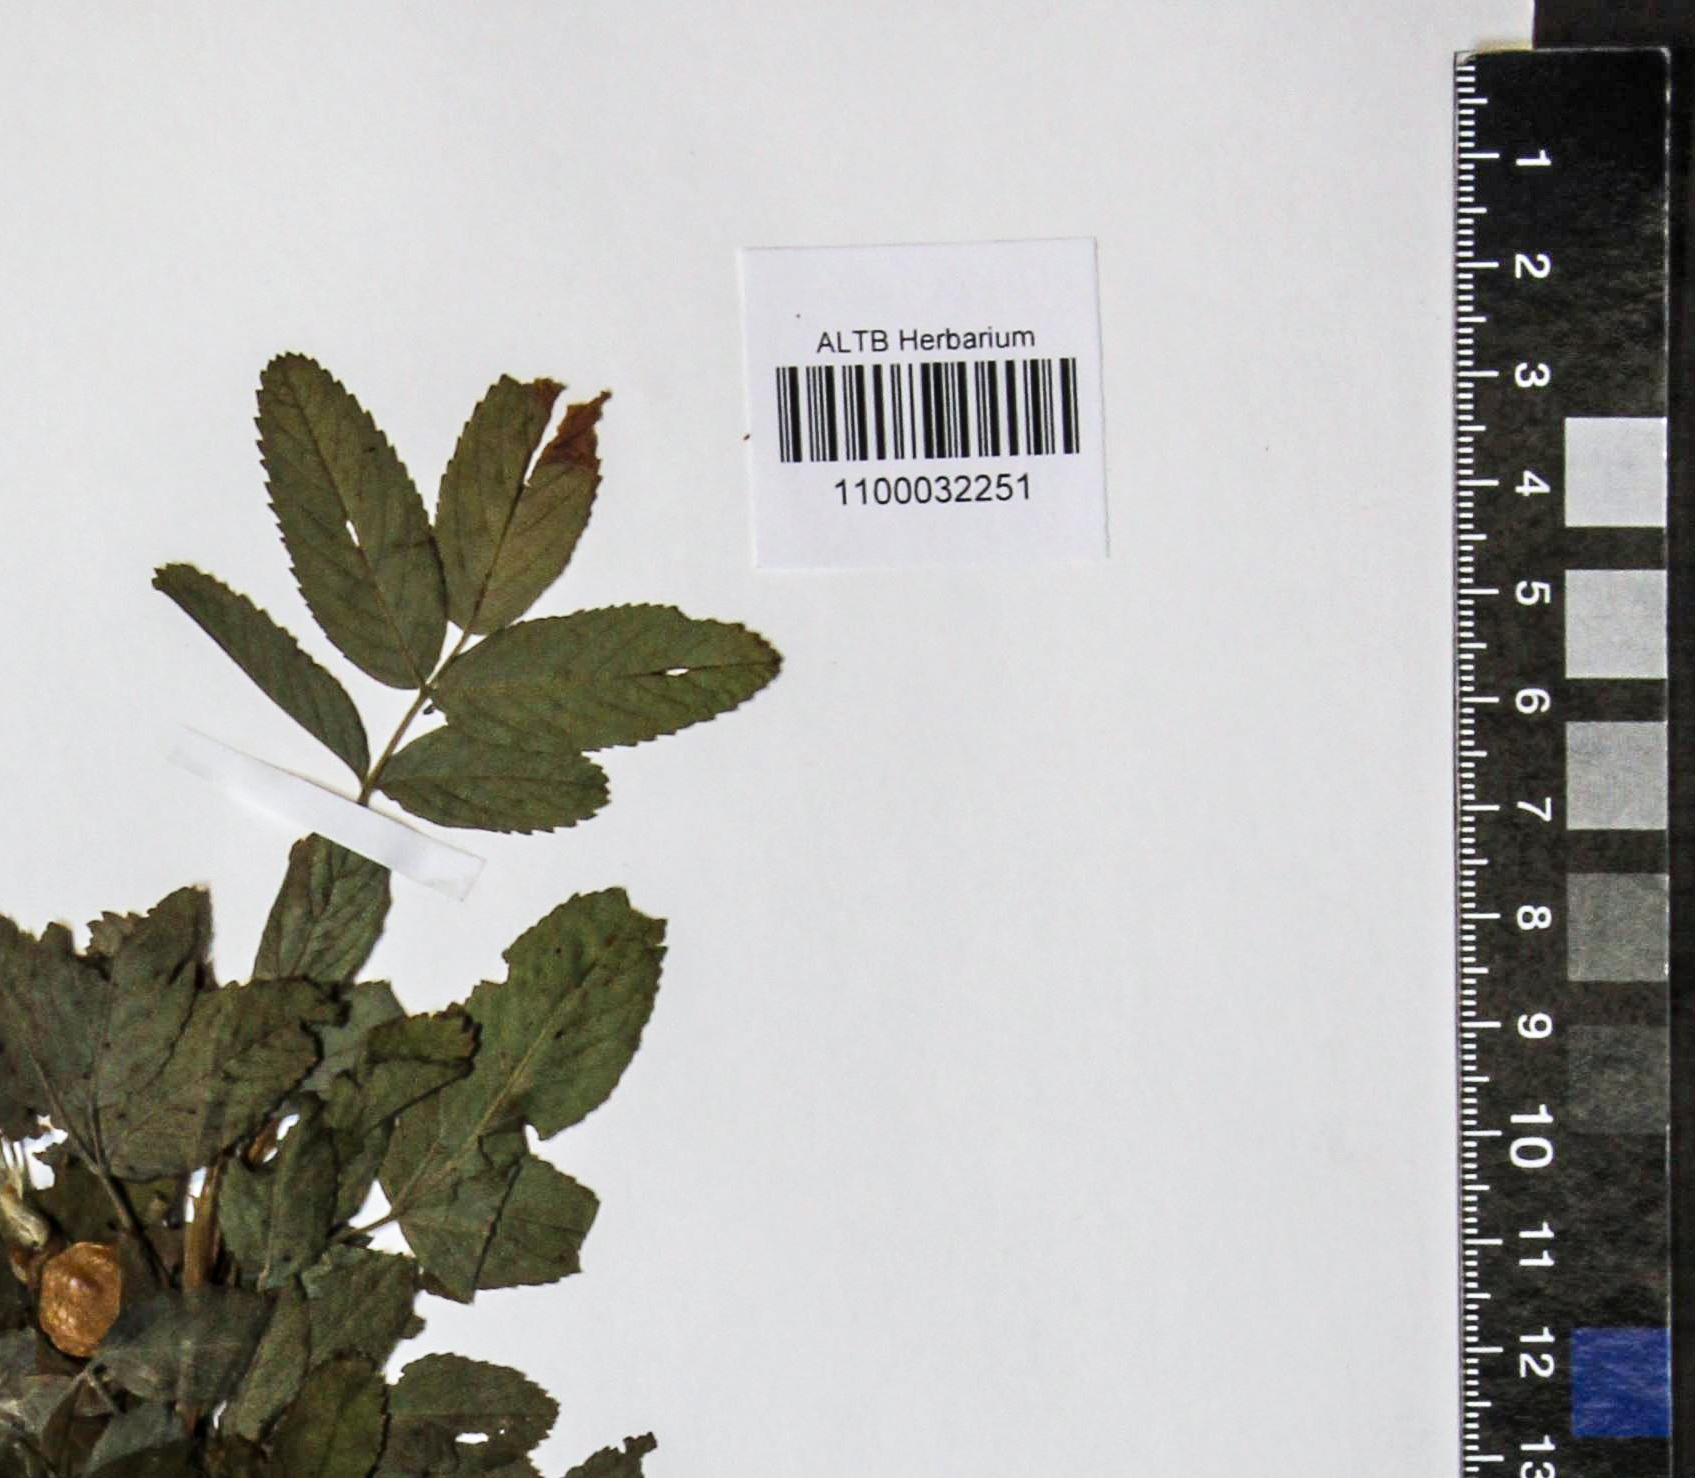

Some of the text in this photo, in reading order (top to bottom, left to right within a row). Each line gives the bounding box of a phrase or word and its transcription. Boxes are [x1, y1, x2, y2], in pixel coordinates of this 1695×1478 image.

[1515, 149, 1552, 167] 1
[1514, 253, 1551, 279] 2
[816, 327, 1036, 354] ALTB Herbarium
[1514, 362, 1551, 388] 3
[834, 472, 1031, 506] 1100032251
[1515, 469, 1551, 497] 4
[1515, 580, 1551, 606] 5
[1514, 688, 1551, 714] 6
[1516, 796, 1552, 822] 7
[1516, 904, 1553, 931] 8
[1517, 1012, 1553, 1039] 9
[1509, 1103, 1554, 1169] 10
[1518, 1221, 1555, 1267] 11
[1519, 1326, 1556, 1378] 12
